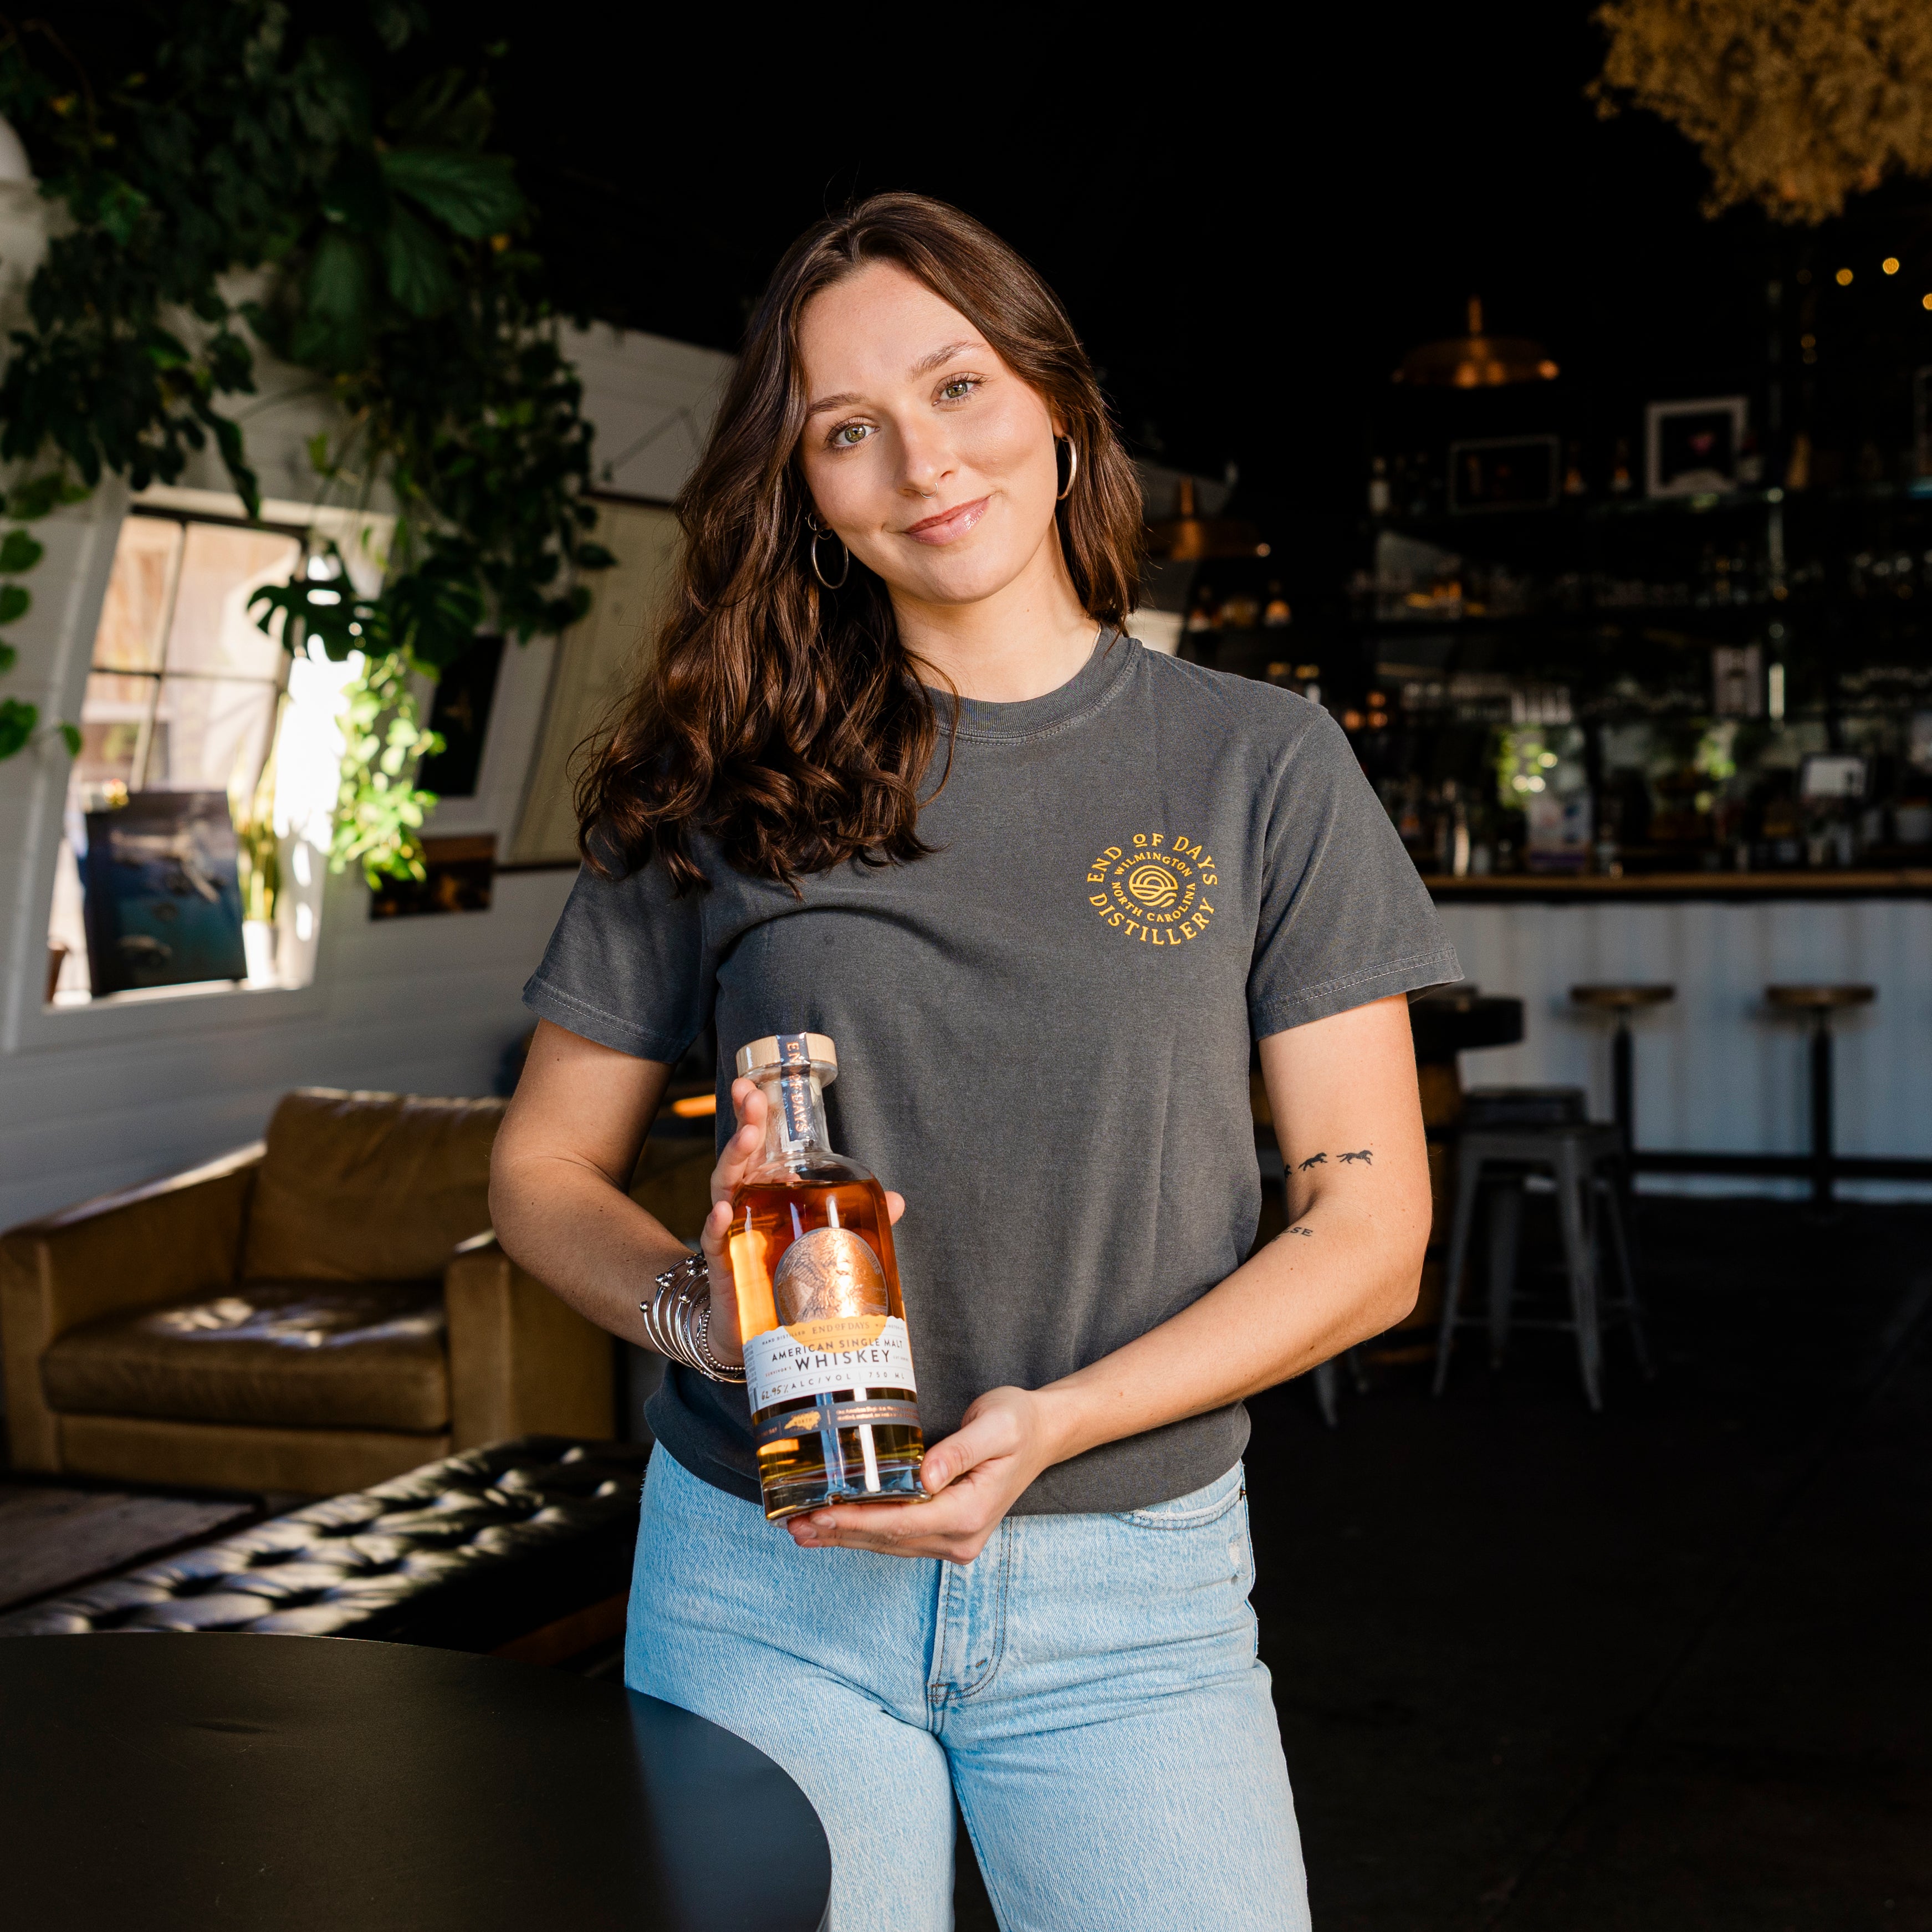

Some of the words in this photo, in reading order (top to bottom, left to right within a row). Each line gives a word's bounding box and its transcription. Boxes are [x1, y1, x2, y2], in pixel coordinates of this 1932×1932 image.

[1087, 846, 1122, 883] END
[1133, 833, 1164, 847] OF
[1172, 836, 1218, 886] DAYS
[1114, 851, 1192, 877] WILMINGTON
[1111, 881, 1143, 917] NORTH
[1147, 882, 1195, 922] CAROLINA
[1089, 897, 1215, 945] DISTILLERY
[791, 1093, 807, 1132] DAYS
[812, 1325, 833, 1335] END
[848, 1321, 870, 1330] DAYS
[772, 1342, 834, 1362] AMERICAN
[840, 1338, 880, 1348] SINGLE
[885, 1339, 903, 1348] MALT
[795, 1349, 890, 1372] WHISKEY
[791, 1373, 851, 1389] ALC/VOL
